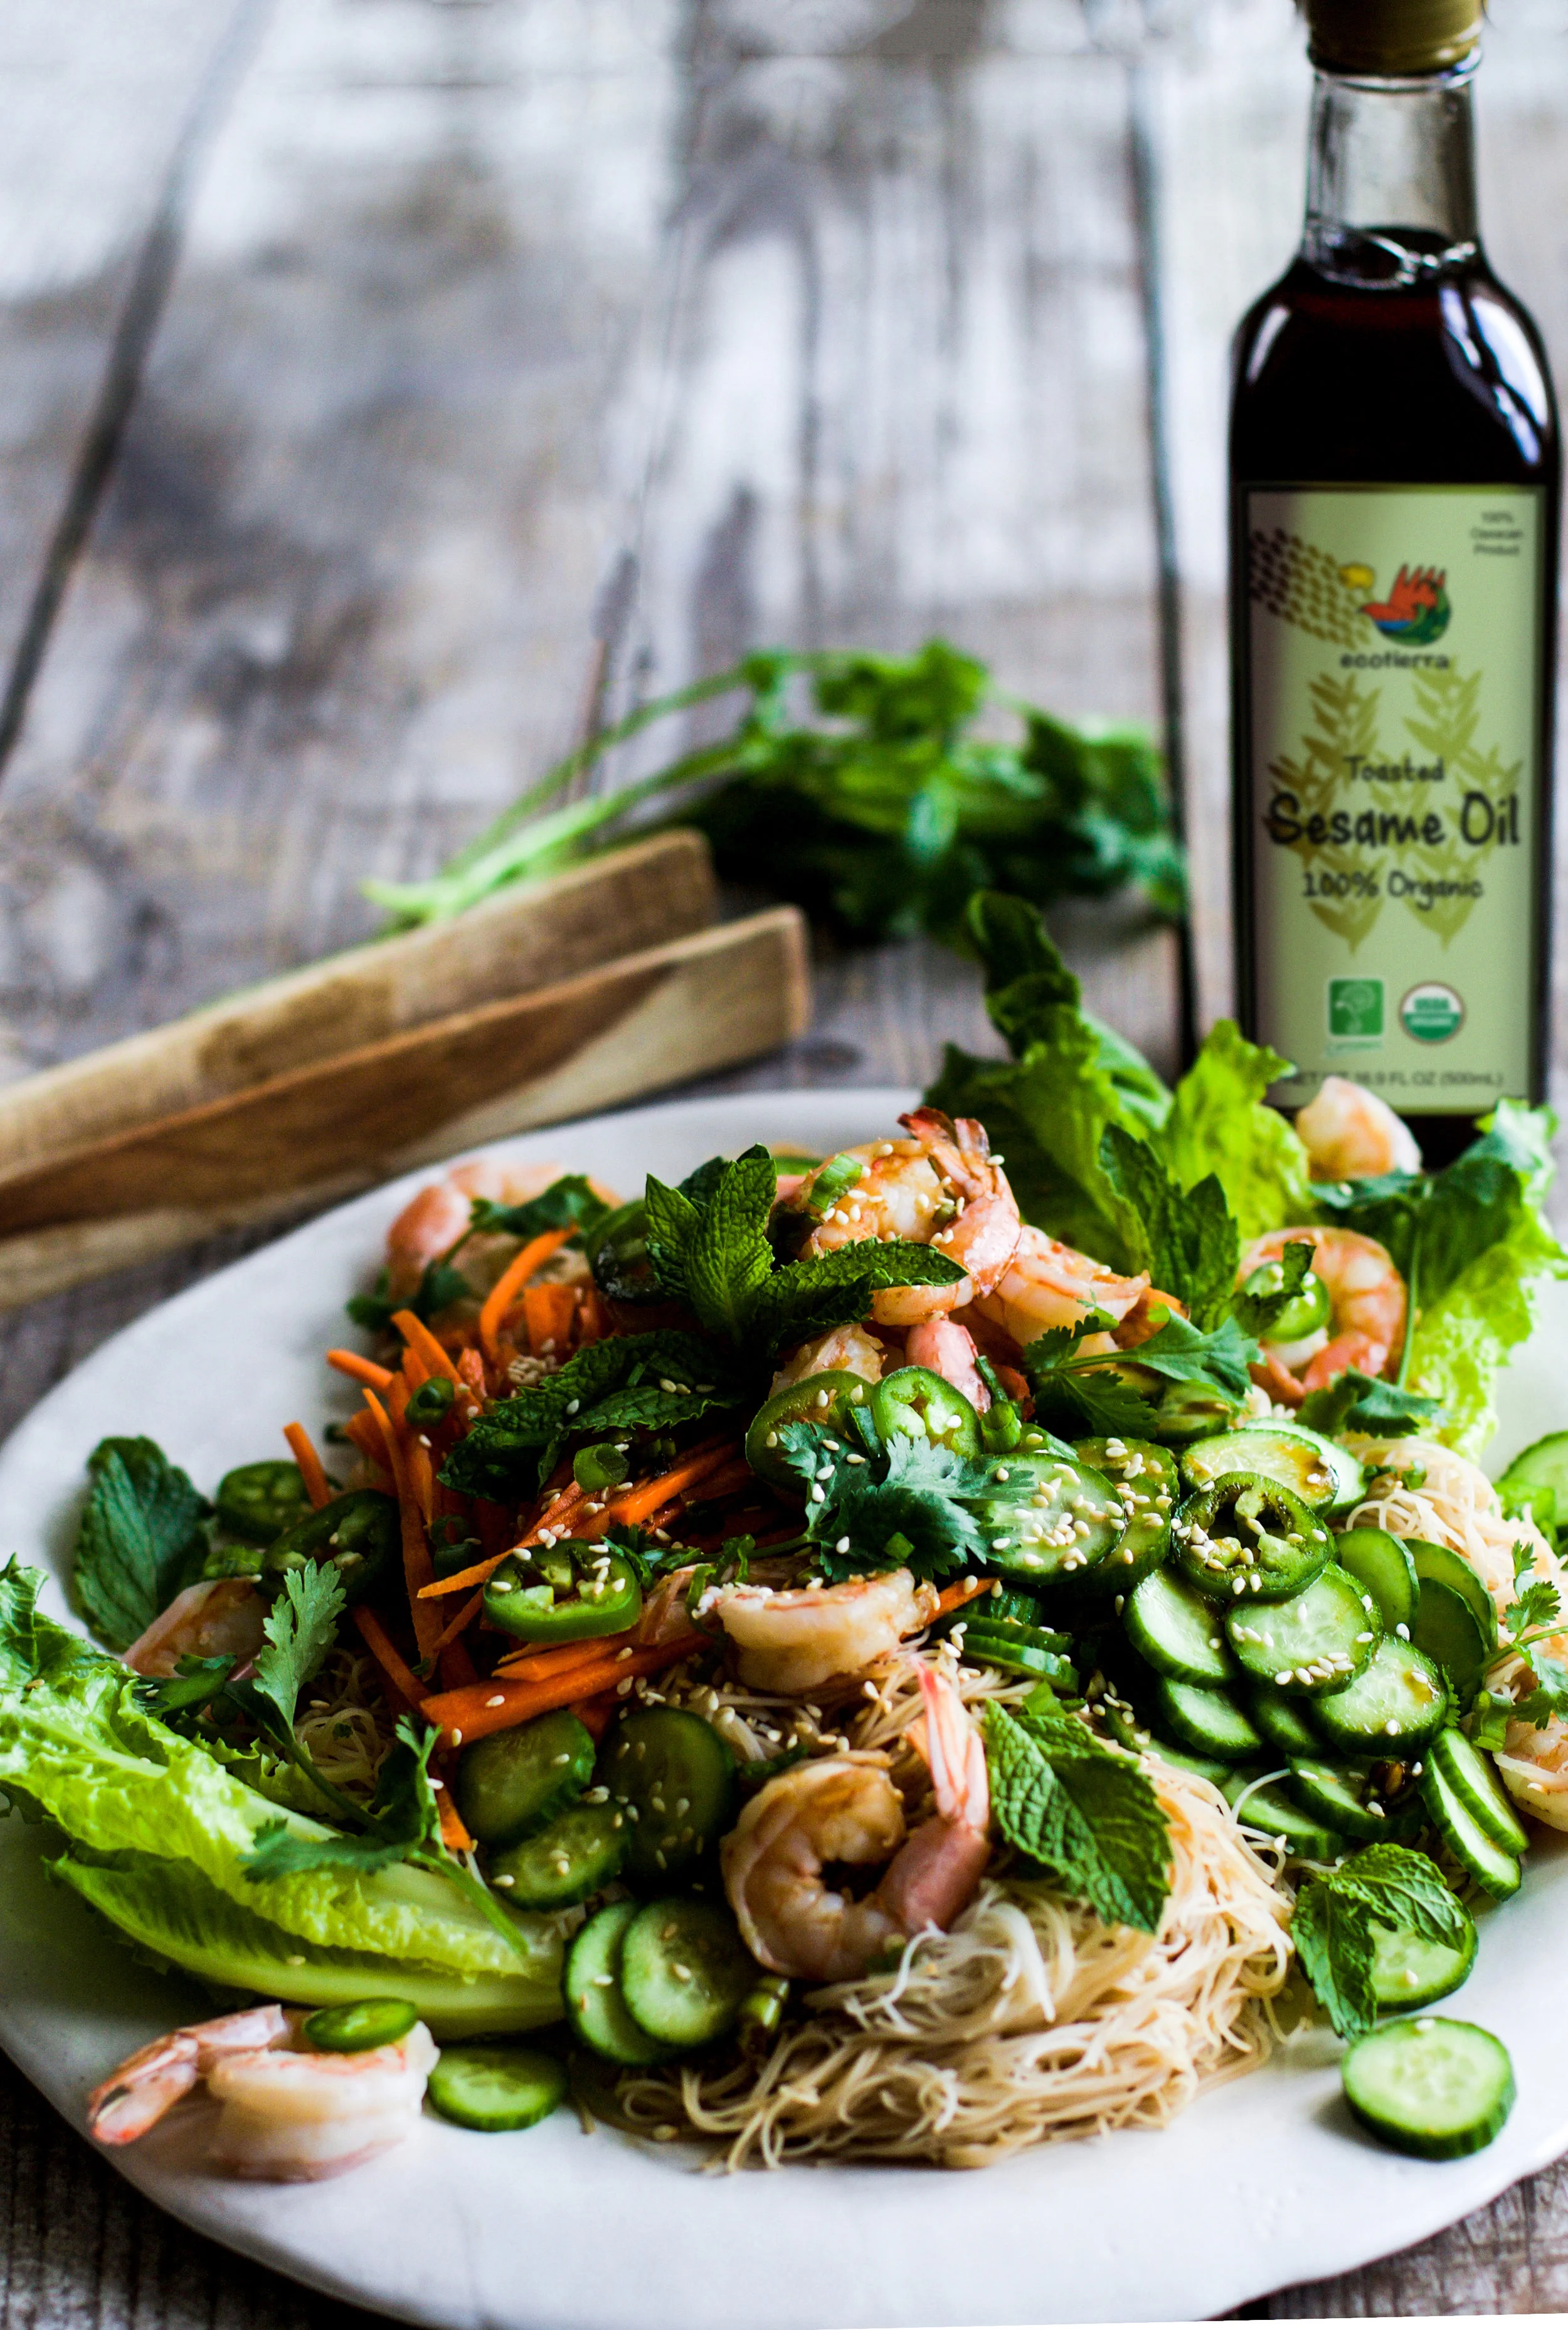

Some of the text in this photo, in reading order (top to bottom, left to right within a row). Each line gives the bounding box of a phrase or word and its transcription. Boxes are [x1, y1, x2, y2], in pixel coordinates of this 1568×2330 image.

[1340, 651, 1450, 669] ecotierra
[1345, 755, 1445, 782] Toasted
[1268, 790, 1518, 847] Sesame Oil
[1303, 871, 1483, 910] 100% Organic
